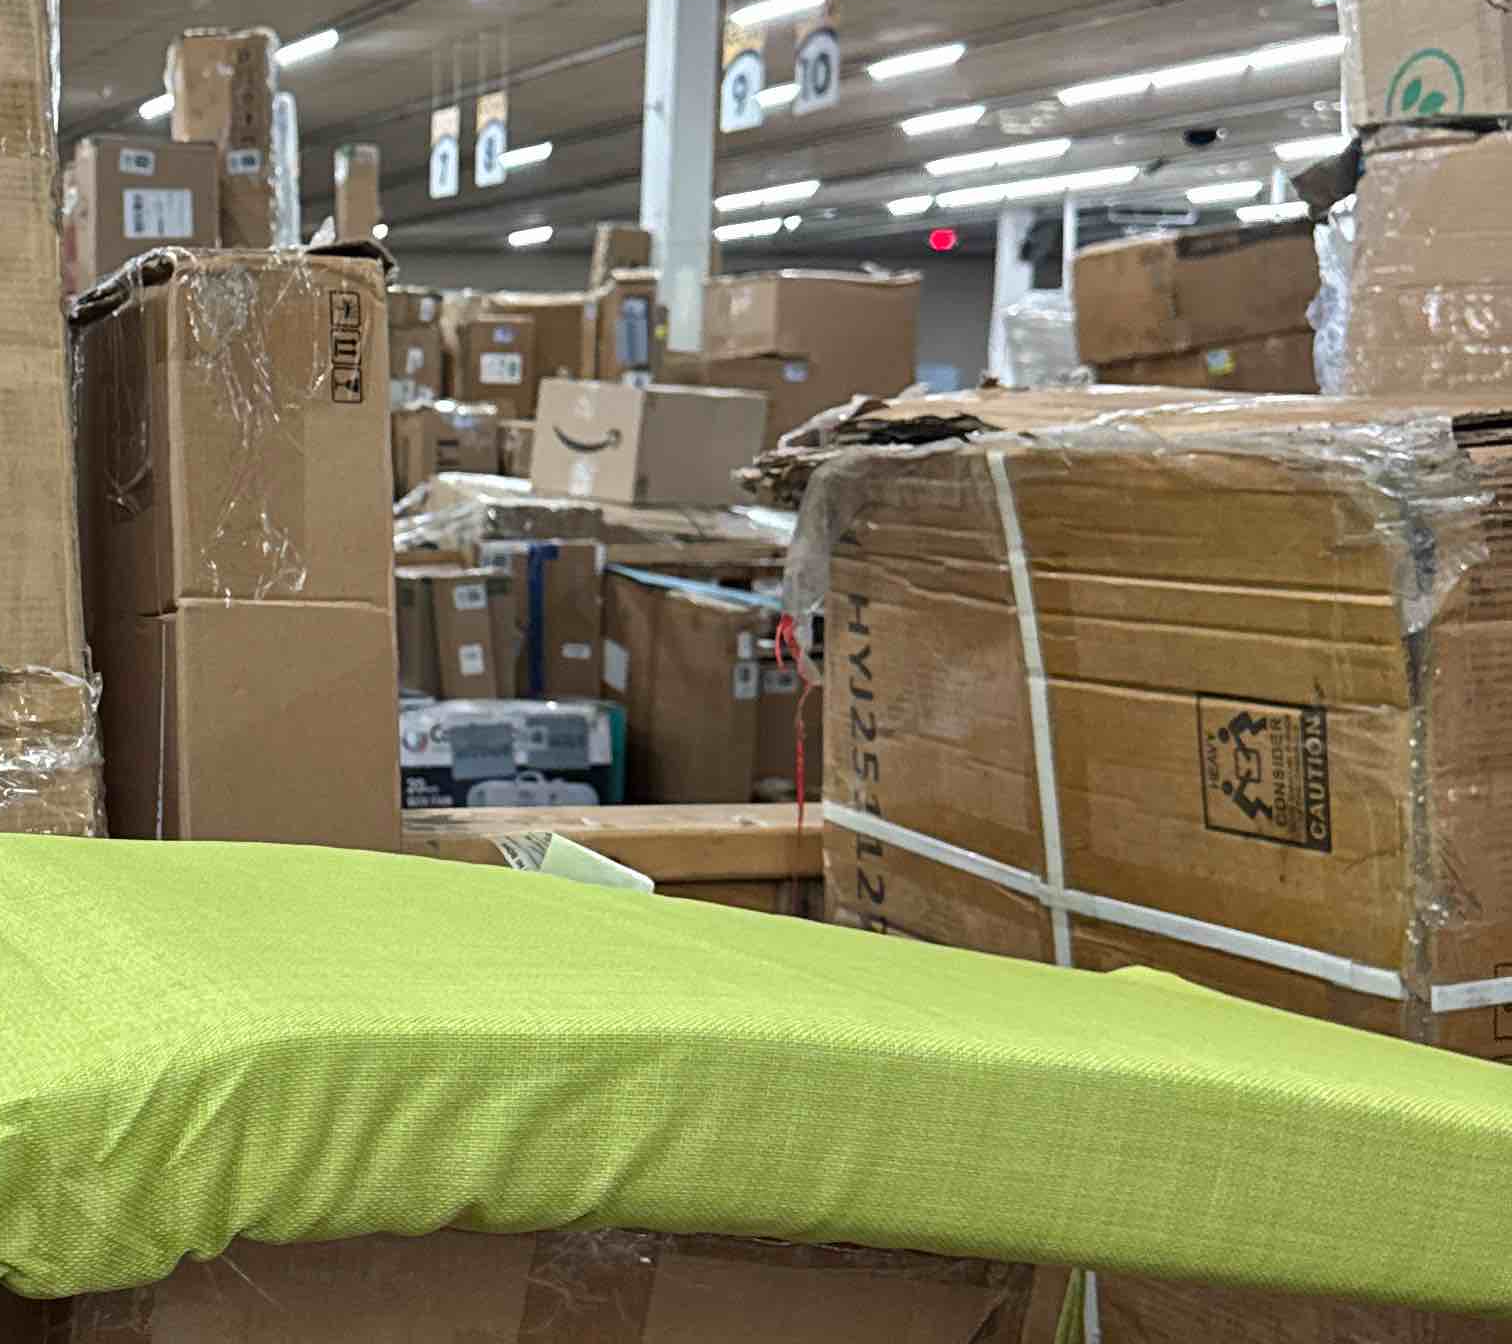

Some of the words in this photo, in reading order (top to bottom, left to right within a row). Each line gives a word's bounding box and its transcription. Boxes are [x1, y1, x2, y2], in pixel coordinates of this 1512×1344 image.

[732, 72, 749, 115] 9
[799, 51, 831, 101] 10
[1304, 712, 1327, 840] CAUTION
